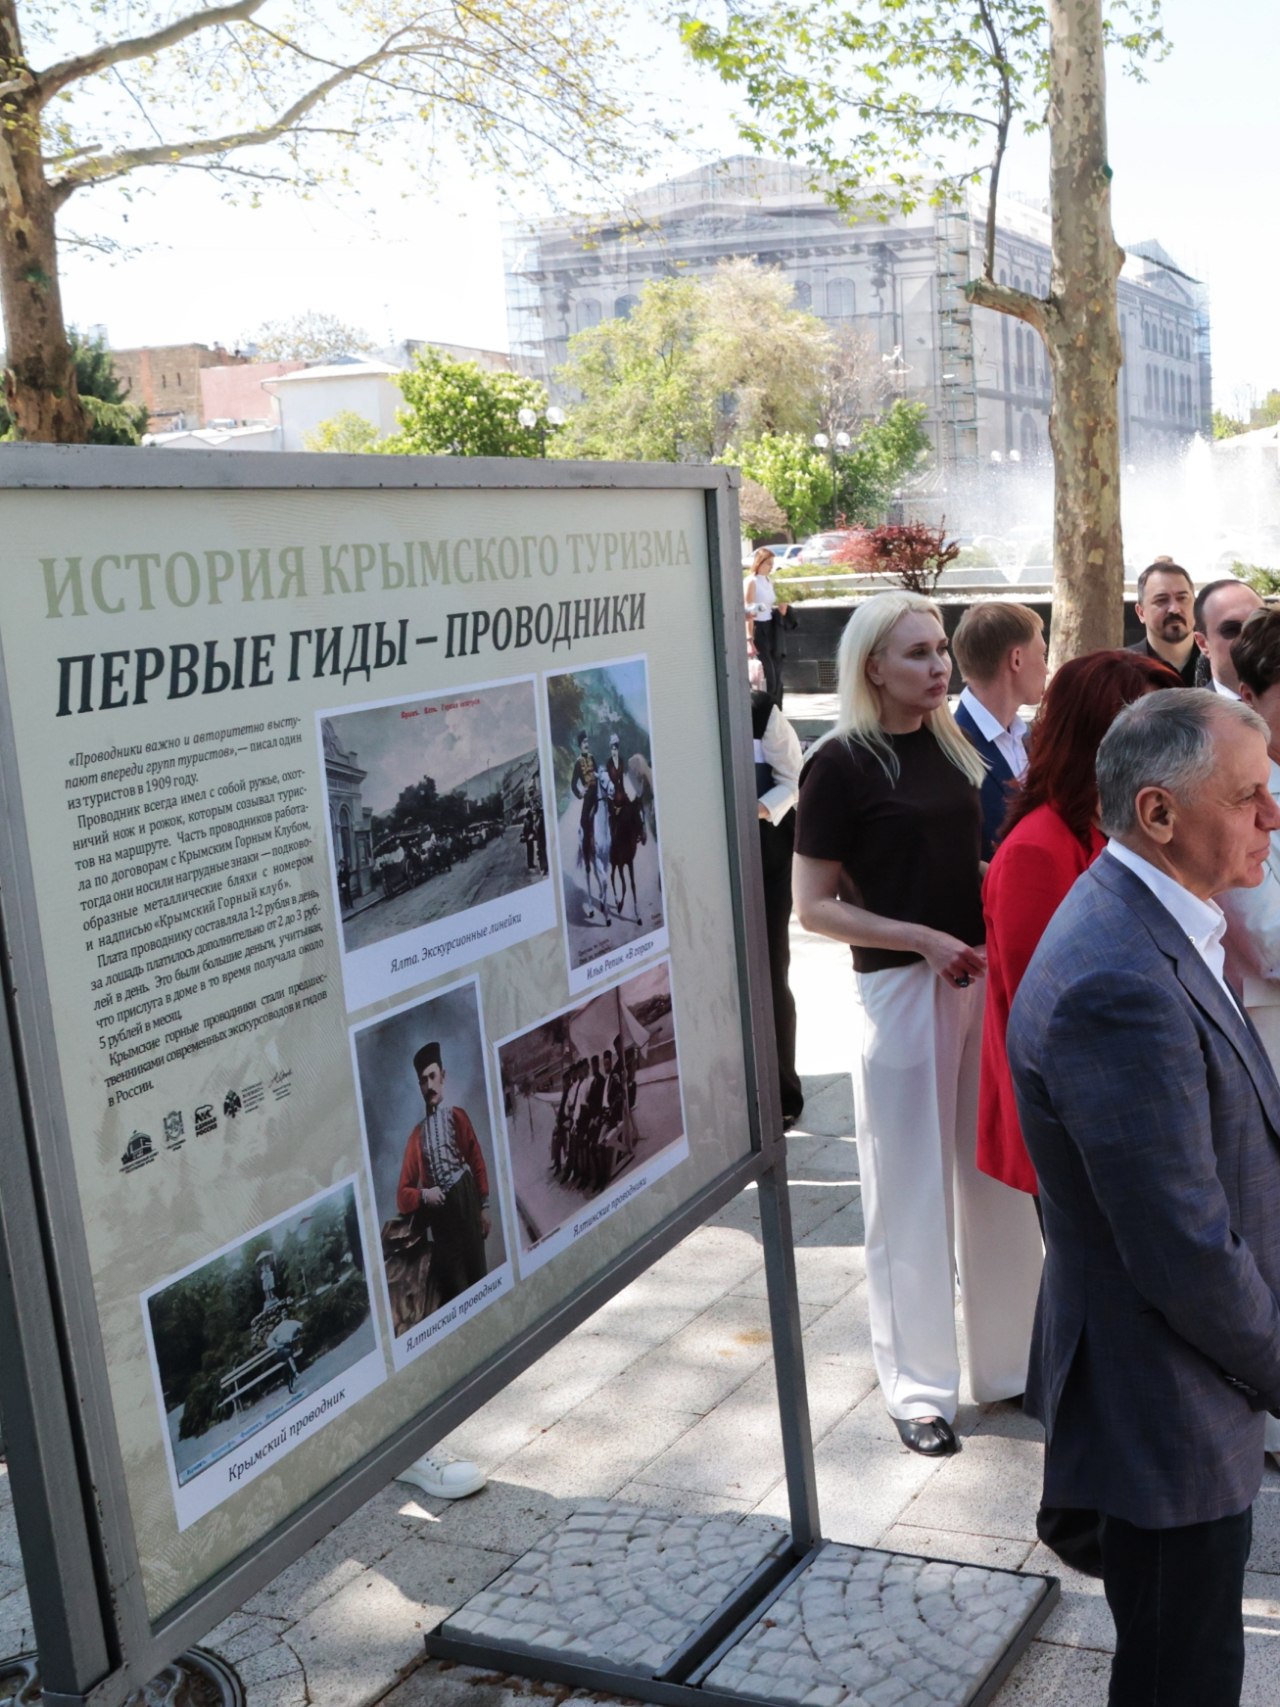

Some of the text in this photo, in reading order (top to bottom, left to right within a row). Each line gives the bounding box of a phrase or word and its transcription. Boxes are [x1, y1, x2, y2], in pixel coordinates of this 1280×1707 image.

[38, 529, 693, 620] ИСТОРИЯ КРЫМСКОГО ТУРИЗМА
[55, 633, 276, 717] ПЕРВЫЕ
[288, 618, 408, 685] ГИДЫ
[445, 592, 648, 658] ПРОВОДНИКИ
[65, 774, 98, 788] пают
[101, 763, 143, 782] впереди
[146, 759, 175, 775] групп
[250, 739, 277, 751] писал
[279, 734, 302, 746] один
[69, 718, 301, 767] «Проводники важно и авторитетно высту-
[67, 773, 198, 810] из туристов в 1909 году.
[73, 787, 307, 850] ничий нож и рожок, которым созывал турис-
[77, 770, 305, 829] Проводник всегда имел с собой ружье, охот-
[75, 805, 308, 870] тов на маршруте. Часть проводников работа-
[78, 822, 311, 891] ла по договорам с Крымским Горным Клубом,
[80, 894, 112, 911] тогда
[113, 888, 134, 901] они
[136, 877, 174, 895] носили
[175, 861, 230, 883] нагрудные
[231, 853, 259, 868] знаки
[272, 839, 312, 856] подково-
[83, 856, 314, 931] образные металлические бляхи с номером
[85, 879, 291, 951] и надписью «Крымский Горный клуб».
[91, 904, 321, 991] за лошадь платилось дополнительно от 2 до 3 руб-
[97, 950, 128, 967] Плата
[130, 929, 192, 958] проводнику
[195, 912, 248, 935] составляла
[264, 898, 290, 916] рубля
[291, 896, 297, 904] в
[391, 912, 522, 974] Ялта. Экскурсионные линейки
[94, 993, 113, 1010] лей
[116, 993, 122, 1002] в
[154, 975, 172, 988] Это
[175, 965, 200, 980] были
[202, 951, 242, 970] большие
[96, 939, 324, 1028] что прислуга в доме в то время получала около
[586, 963, 604, 980] Илья
[99, 1036, 106, 1049] 5
[108, 1022, 143, 1049] рублей
[145, 1022, 151, 1031] в
[104, 991, 327, 1087] твенниками современных экскурсоводов и гидов
[109, 1038, 160, 1066] Крымские
[165, 1023, 199, 1043] горные
[203, 1001, 257, 1028] проводники
[261, 990, 284, 1005] стали
[108, 1081, 154, 1107] в России.
[573, 1175, 648, 1238] Ялтинские проводники
[406, 1276, 504, 1353] Ялтинский проводник
[228, 1387, 347, 1482] Крымский проводник
